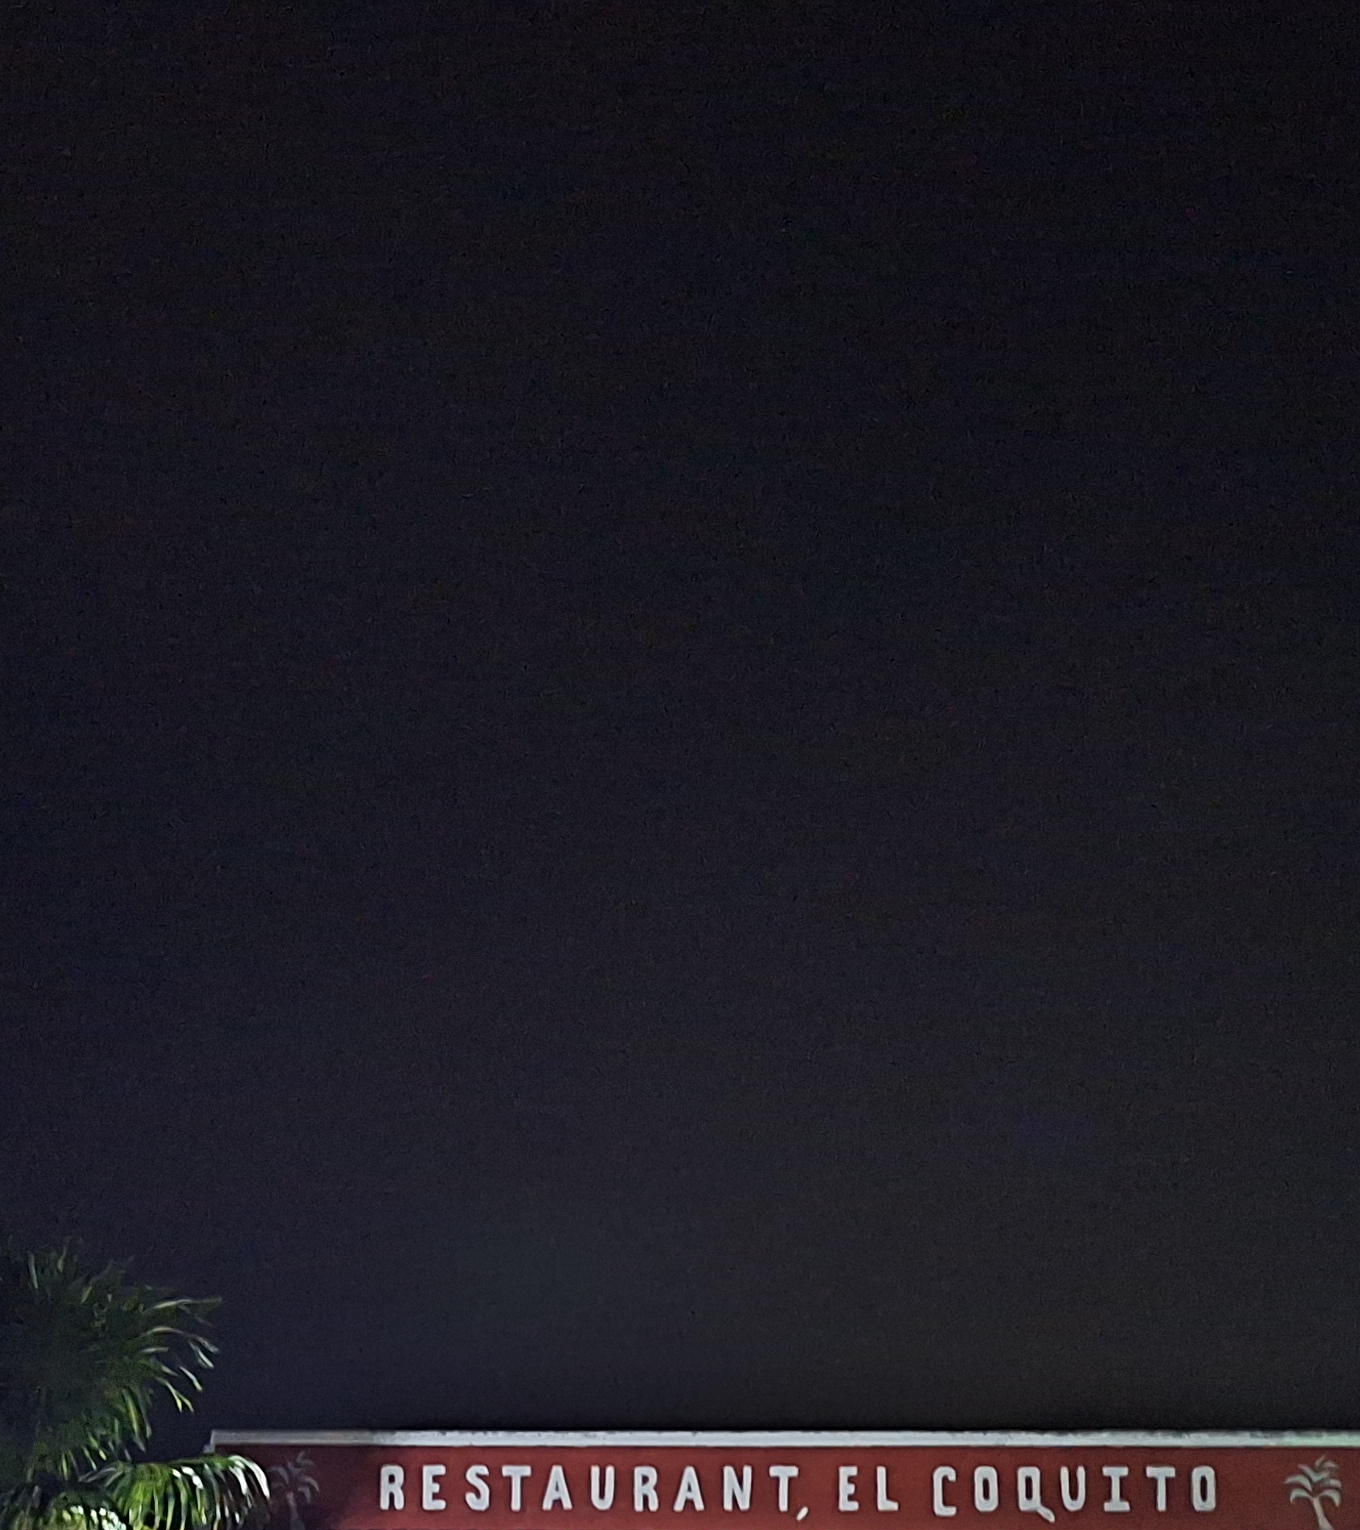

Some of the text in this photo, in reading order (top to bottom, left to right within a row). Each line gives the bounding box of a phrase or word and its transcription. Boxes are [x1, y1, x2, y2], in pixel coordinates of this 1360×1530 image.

[378, 1464, 1217, 1523] RESTAURANT, EL COQUITO
